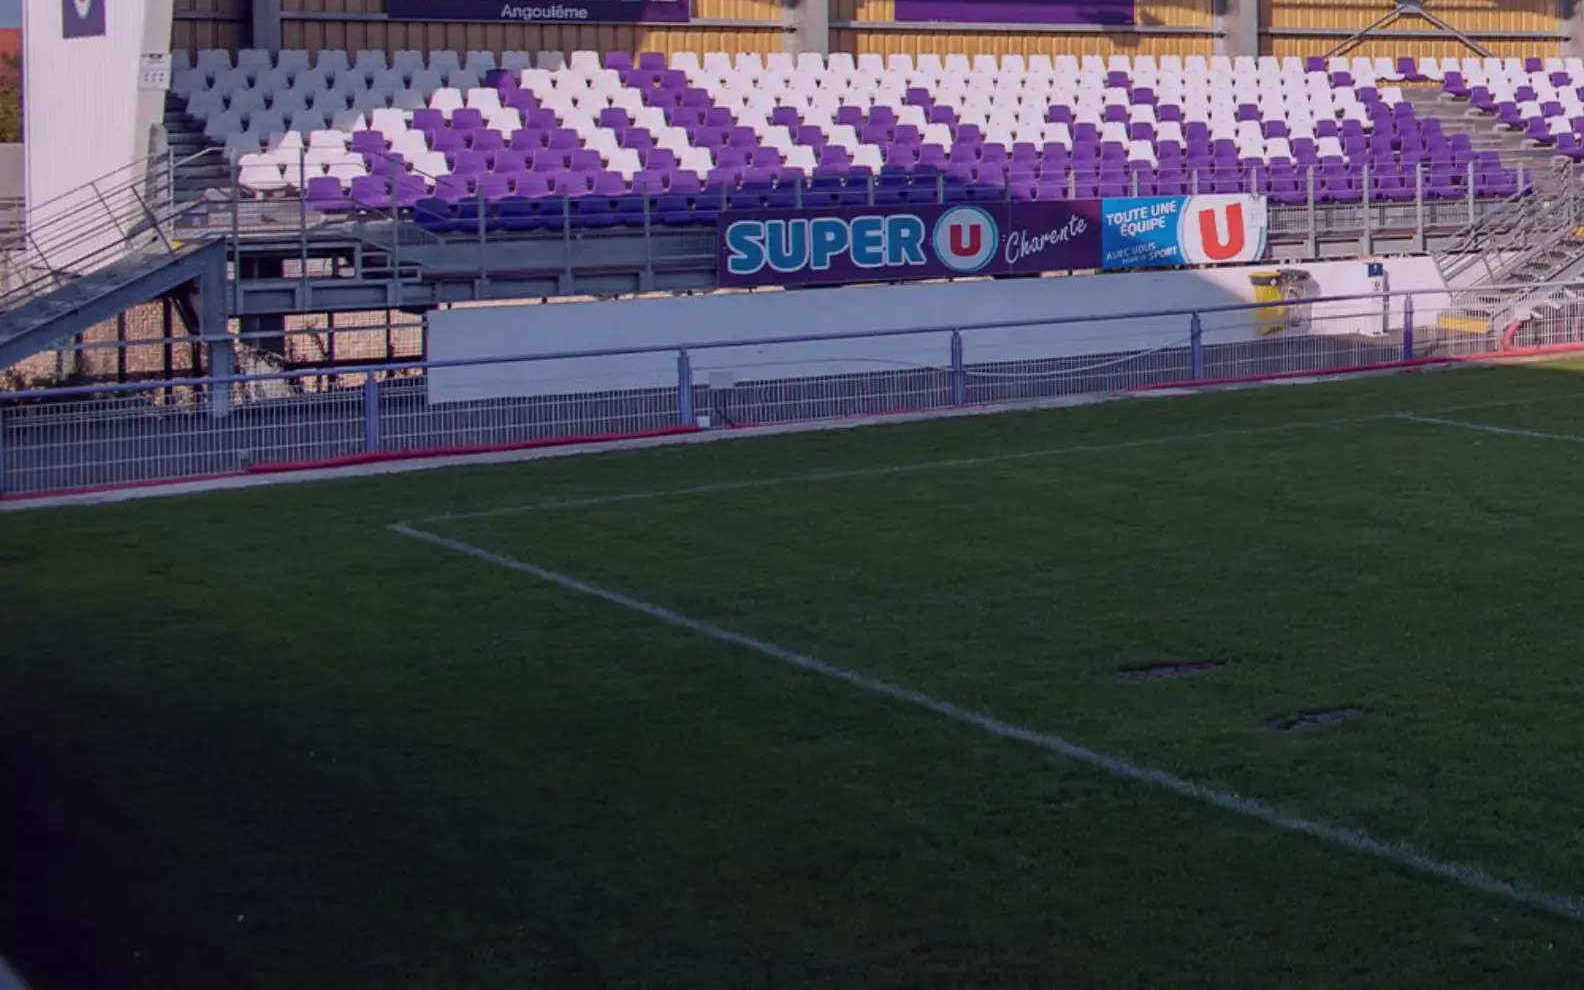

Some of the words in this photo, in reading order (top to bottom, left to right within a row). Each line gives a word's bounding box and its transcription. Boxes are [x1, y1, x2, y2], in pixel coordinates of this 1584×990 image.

[501, 4, 589, 21] Angoulême
[1106, 206, 1148, 226] TOUTE
[1151, 200, 1177, 216] UNE
[1198, 202, 1244, 260] U
[726, 214, 927, 274] SUPER
[950, 224, 981, 257] U
[1005, 214, 1087, 263] Charente
